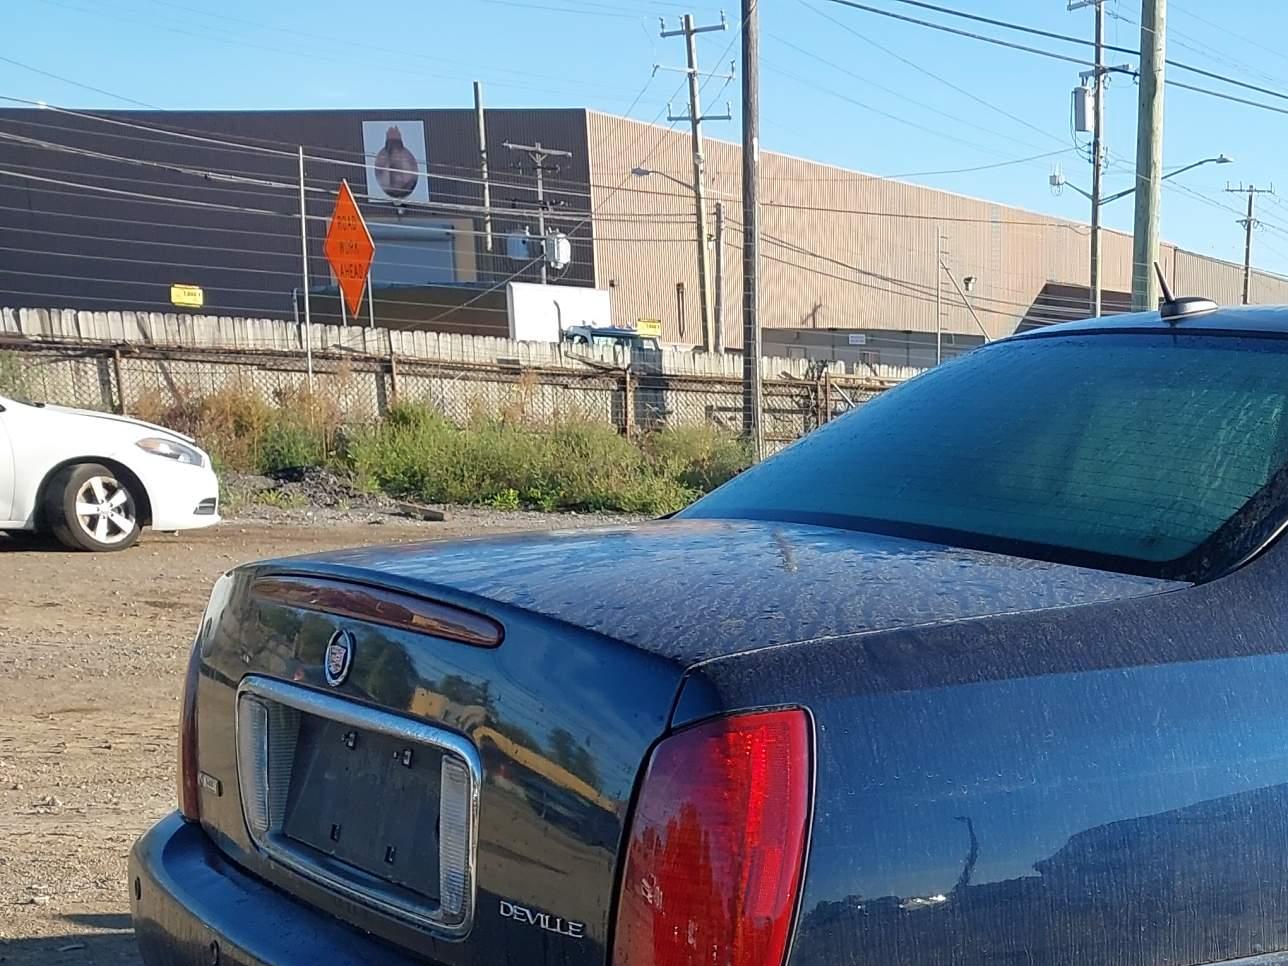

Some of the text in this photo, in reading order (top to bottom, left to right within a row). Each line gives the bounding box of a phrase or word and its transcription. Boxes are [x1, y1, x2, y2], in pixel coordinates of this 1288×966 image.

[337, 216, 357, 230] ROAD
[340, 241, 359, 255] WORK
[340, 264, 364, 279] AHEAD
[500, 901, 585, 938] DEVILLE
